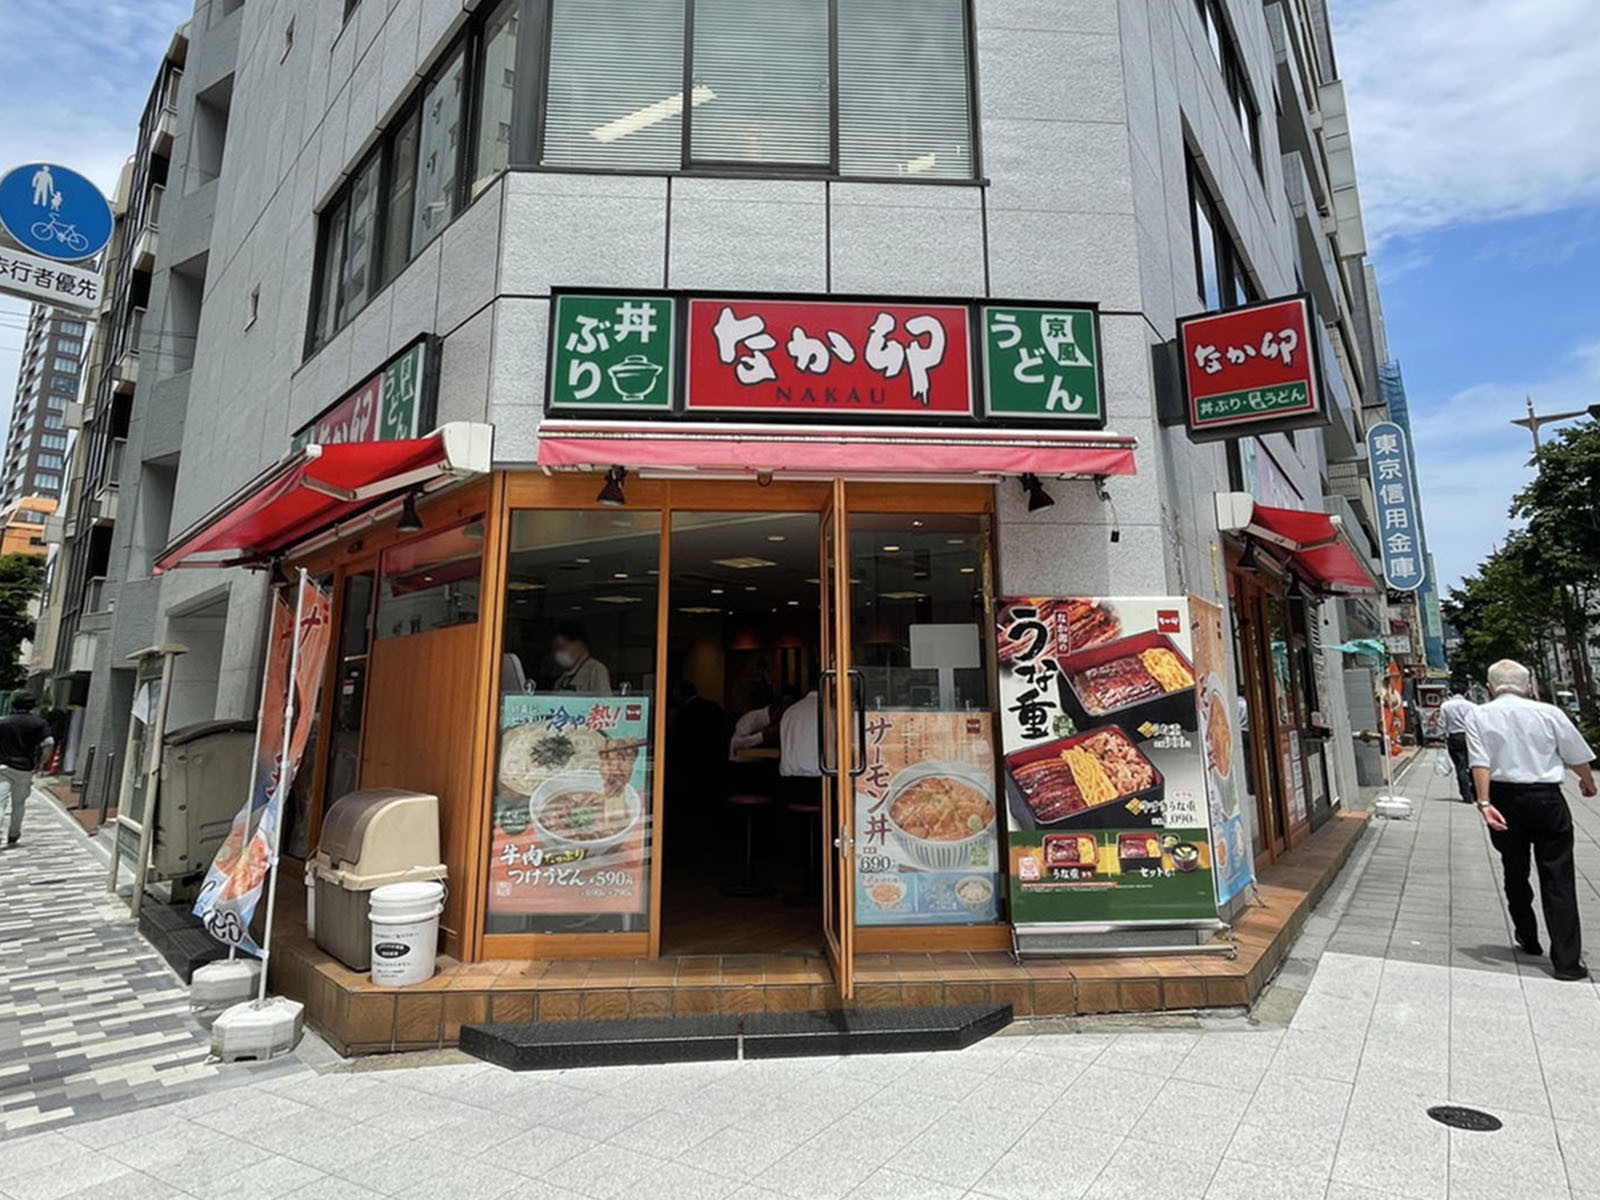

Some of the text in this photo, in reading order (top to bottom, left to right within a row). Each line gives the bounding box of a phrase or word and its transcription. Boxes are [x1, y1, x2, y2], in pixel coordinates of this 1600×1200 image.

[713, 306, 947, 407] なか卯
[775, 386, 886, 405] NAKAU
[990, 313, 1083, 411] 京風 うどん
[1194, 328, 1298, 375] なか卯
[1373, 433, 1417, 578] 東京信用金庫
[1007, 608, 1060, 739] うな重
[865, 717, 893, 845] サーモン丼
[501, 844, 543, 867] 牛肉
[507, 868, 586, 887] つけうどん
